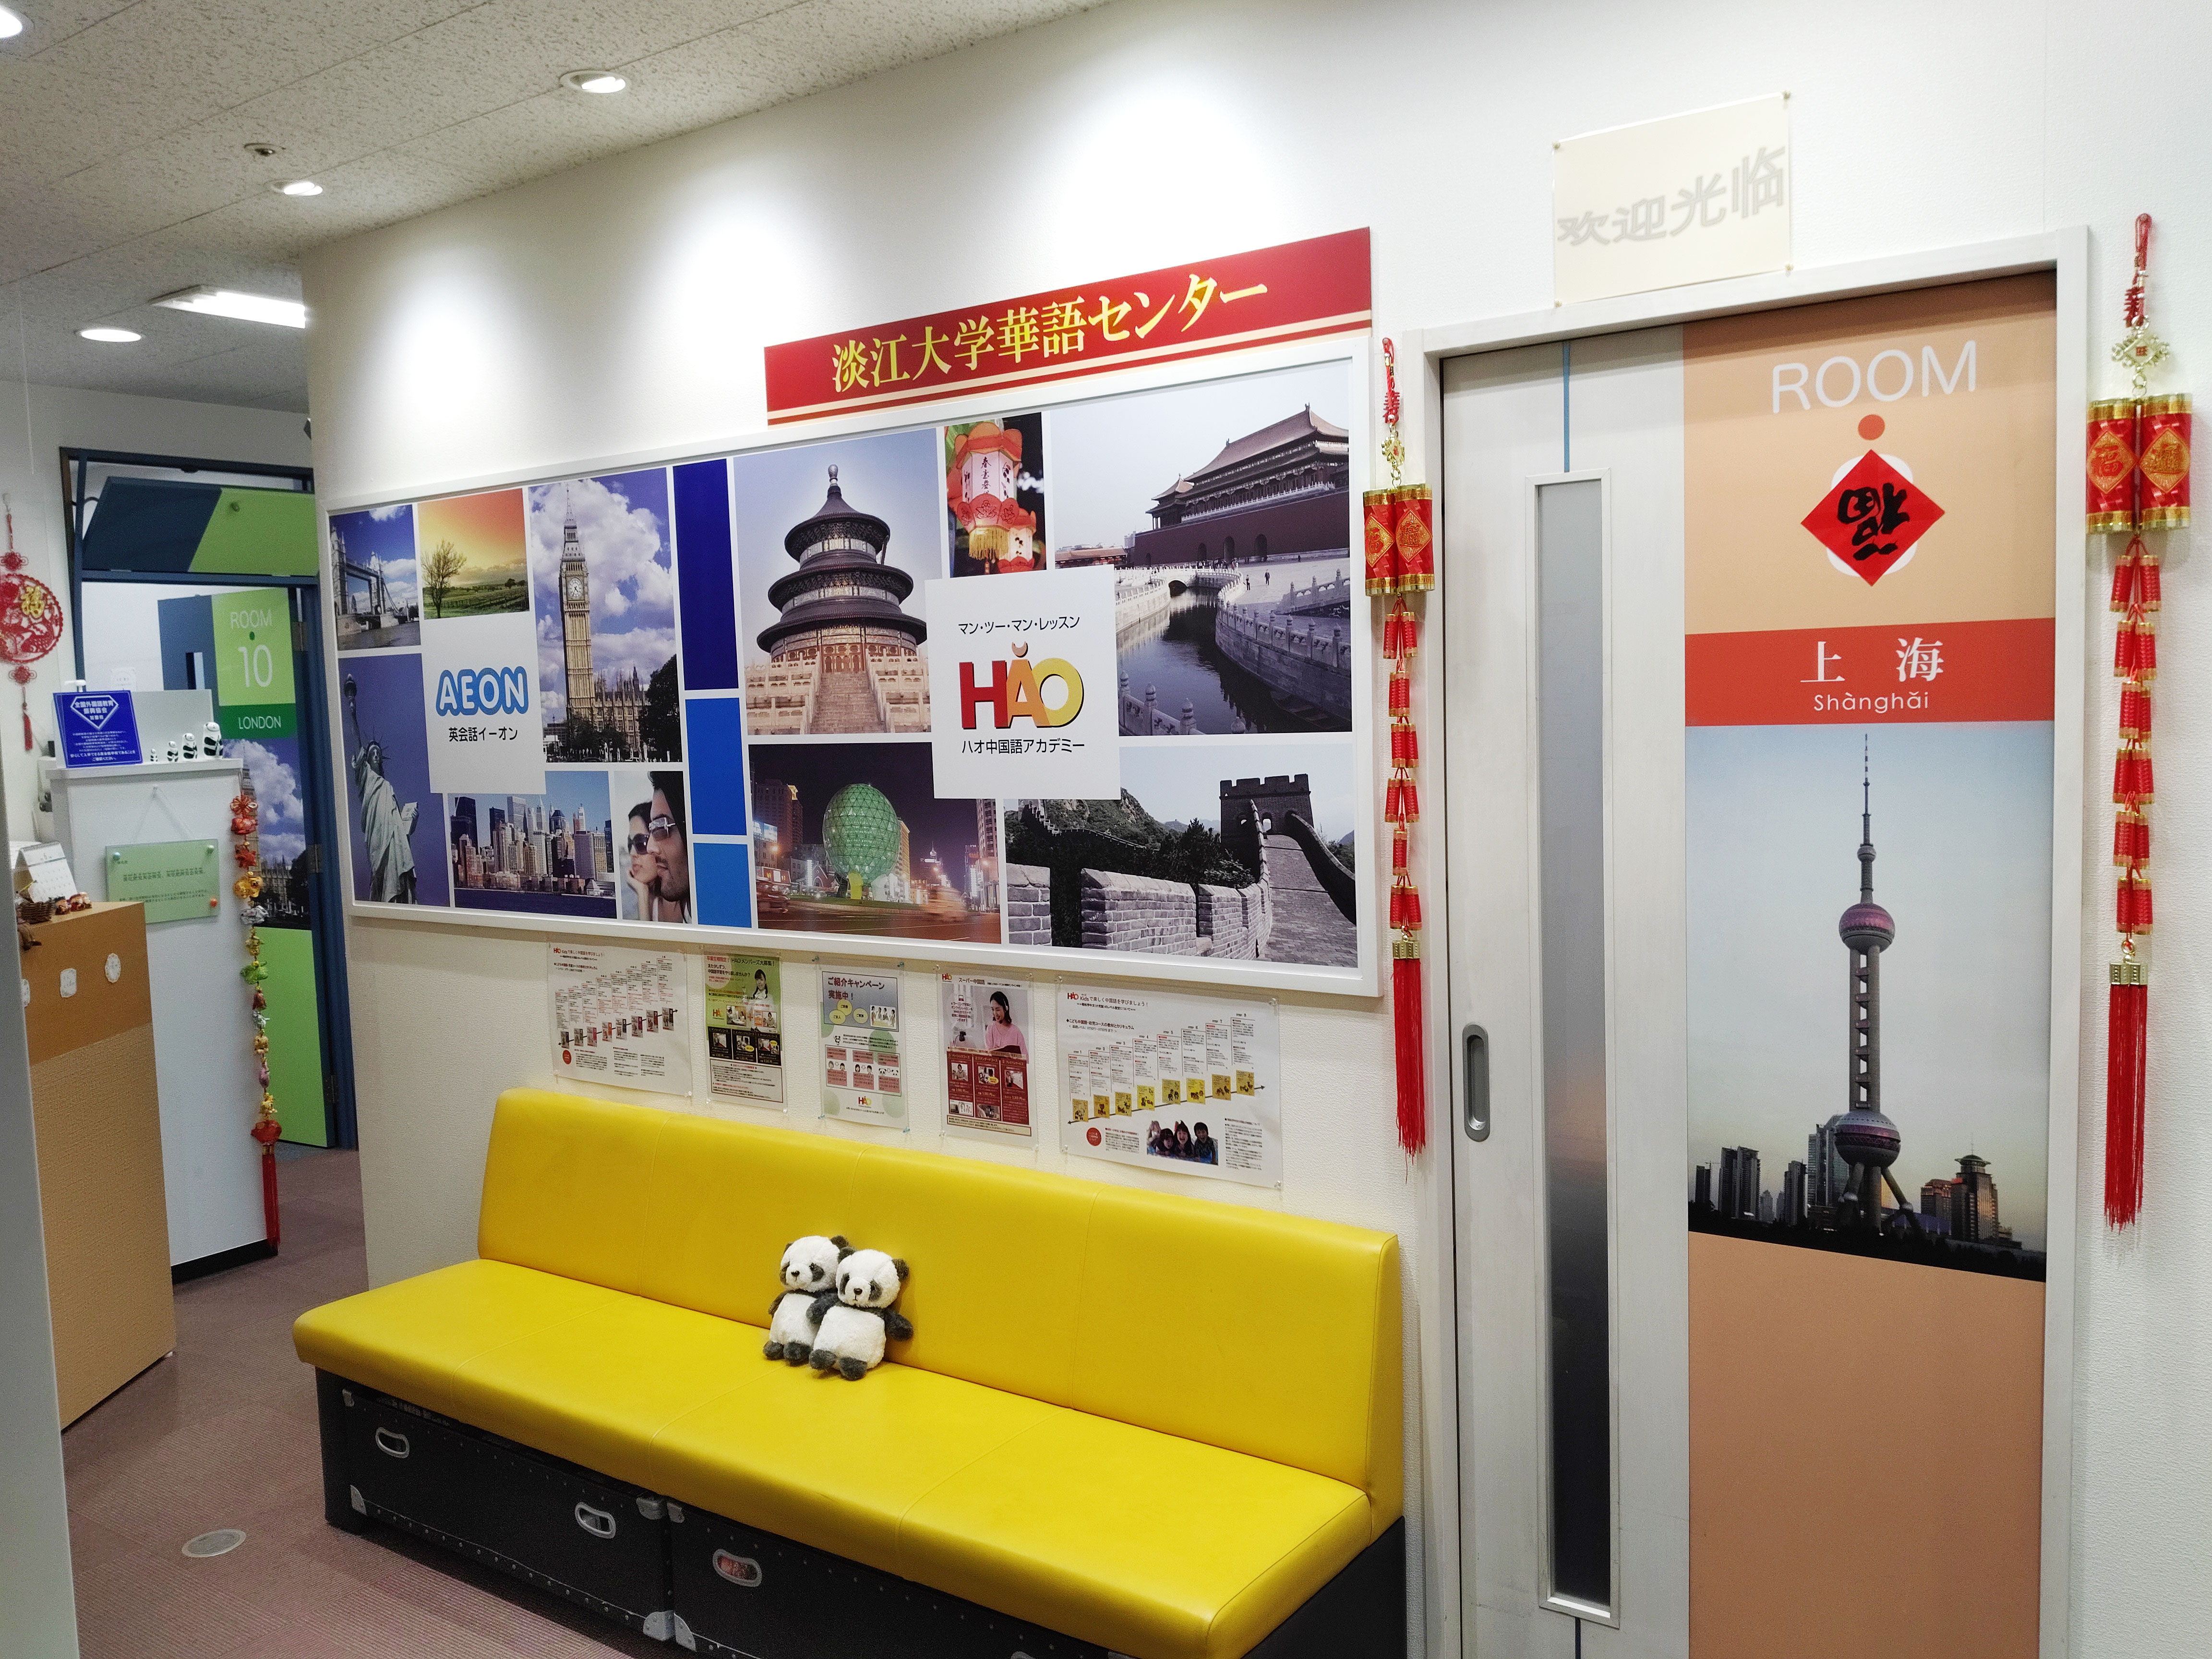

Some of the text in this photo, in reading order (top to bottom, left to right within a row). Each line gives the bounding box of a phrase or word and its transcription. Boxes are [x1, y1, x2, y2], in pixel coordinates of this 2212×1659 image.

[1557, 146, 1786, 246] 欢迎光临
[831, 273, 1268, 393] 淡江大学華語センター
[1772, 340, 1977, 414] ROOM
[230, 609, 272, 629] ROOM
[958, 616, 1081, 635] マン・ツー・マン・レッスン
[238, 644, 273, 688] 10
[1801, 637, 1944, 683] 上海
[436, 666, 529, 716] AEON
[238, 716, 282, 729] LONDON
[448, 726, 518, 742] 英会話イーオン
[962, 738, 1085, 754] ハオ中国語アカデミー
[828, 976, 885, 990] ご紹介キャンペーン
[828, 990, 853, 1000] 実施中！
